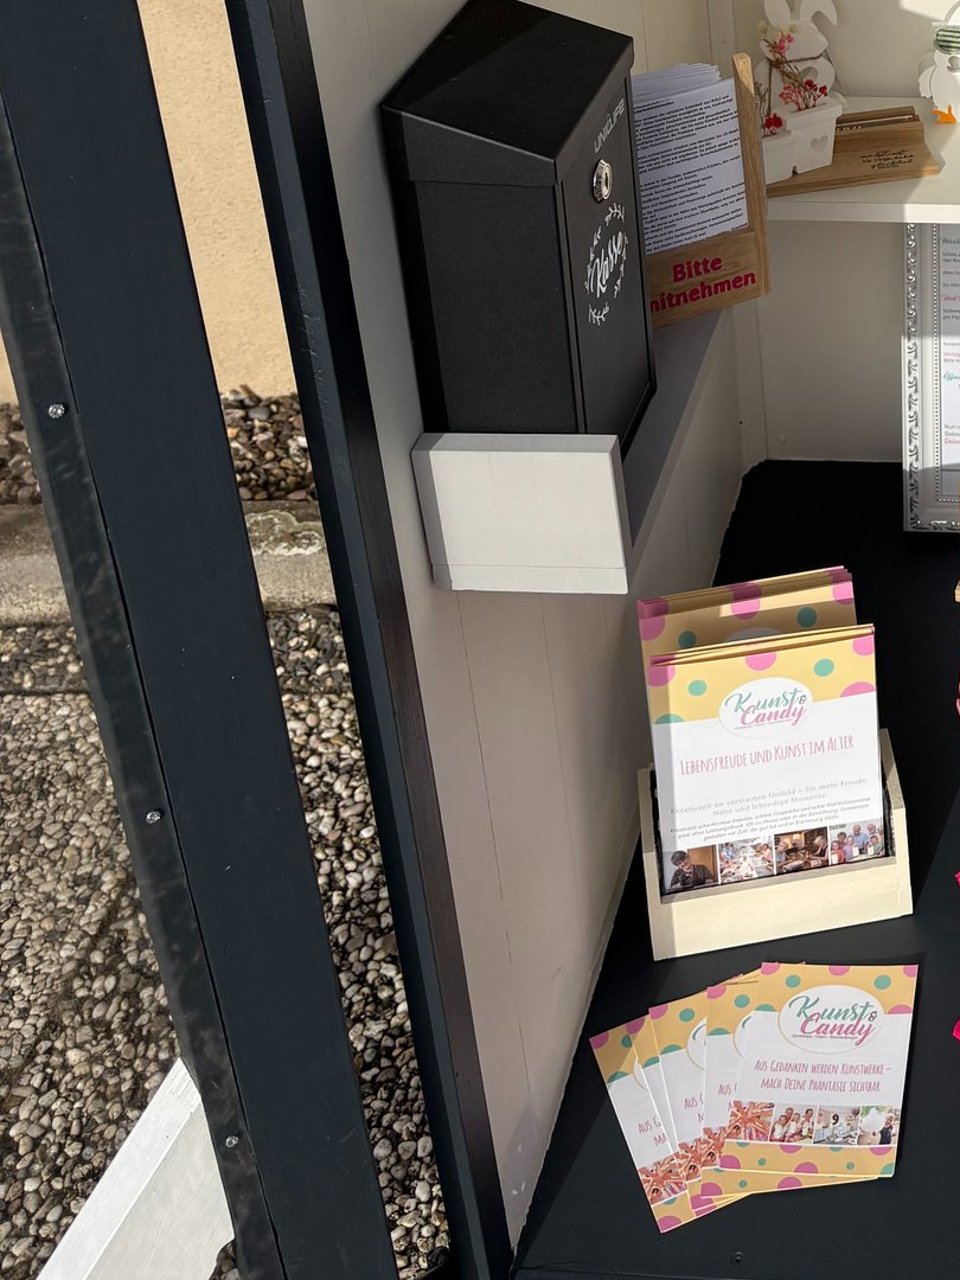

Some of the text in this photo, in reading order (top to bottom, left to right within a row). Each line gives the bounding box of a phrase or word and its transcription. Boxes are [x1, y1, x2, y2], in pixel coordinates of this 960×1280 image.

[672, 257, 722, 283] Bitte
[724, 687, 800, 713] Kunst
[740, 705, 807, 727] Candy
[788, 995, 878, 1022] Kunst &
[800, 1012, 876, 1046] Candy
